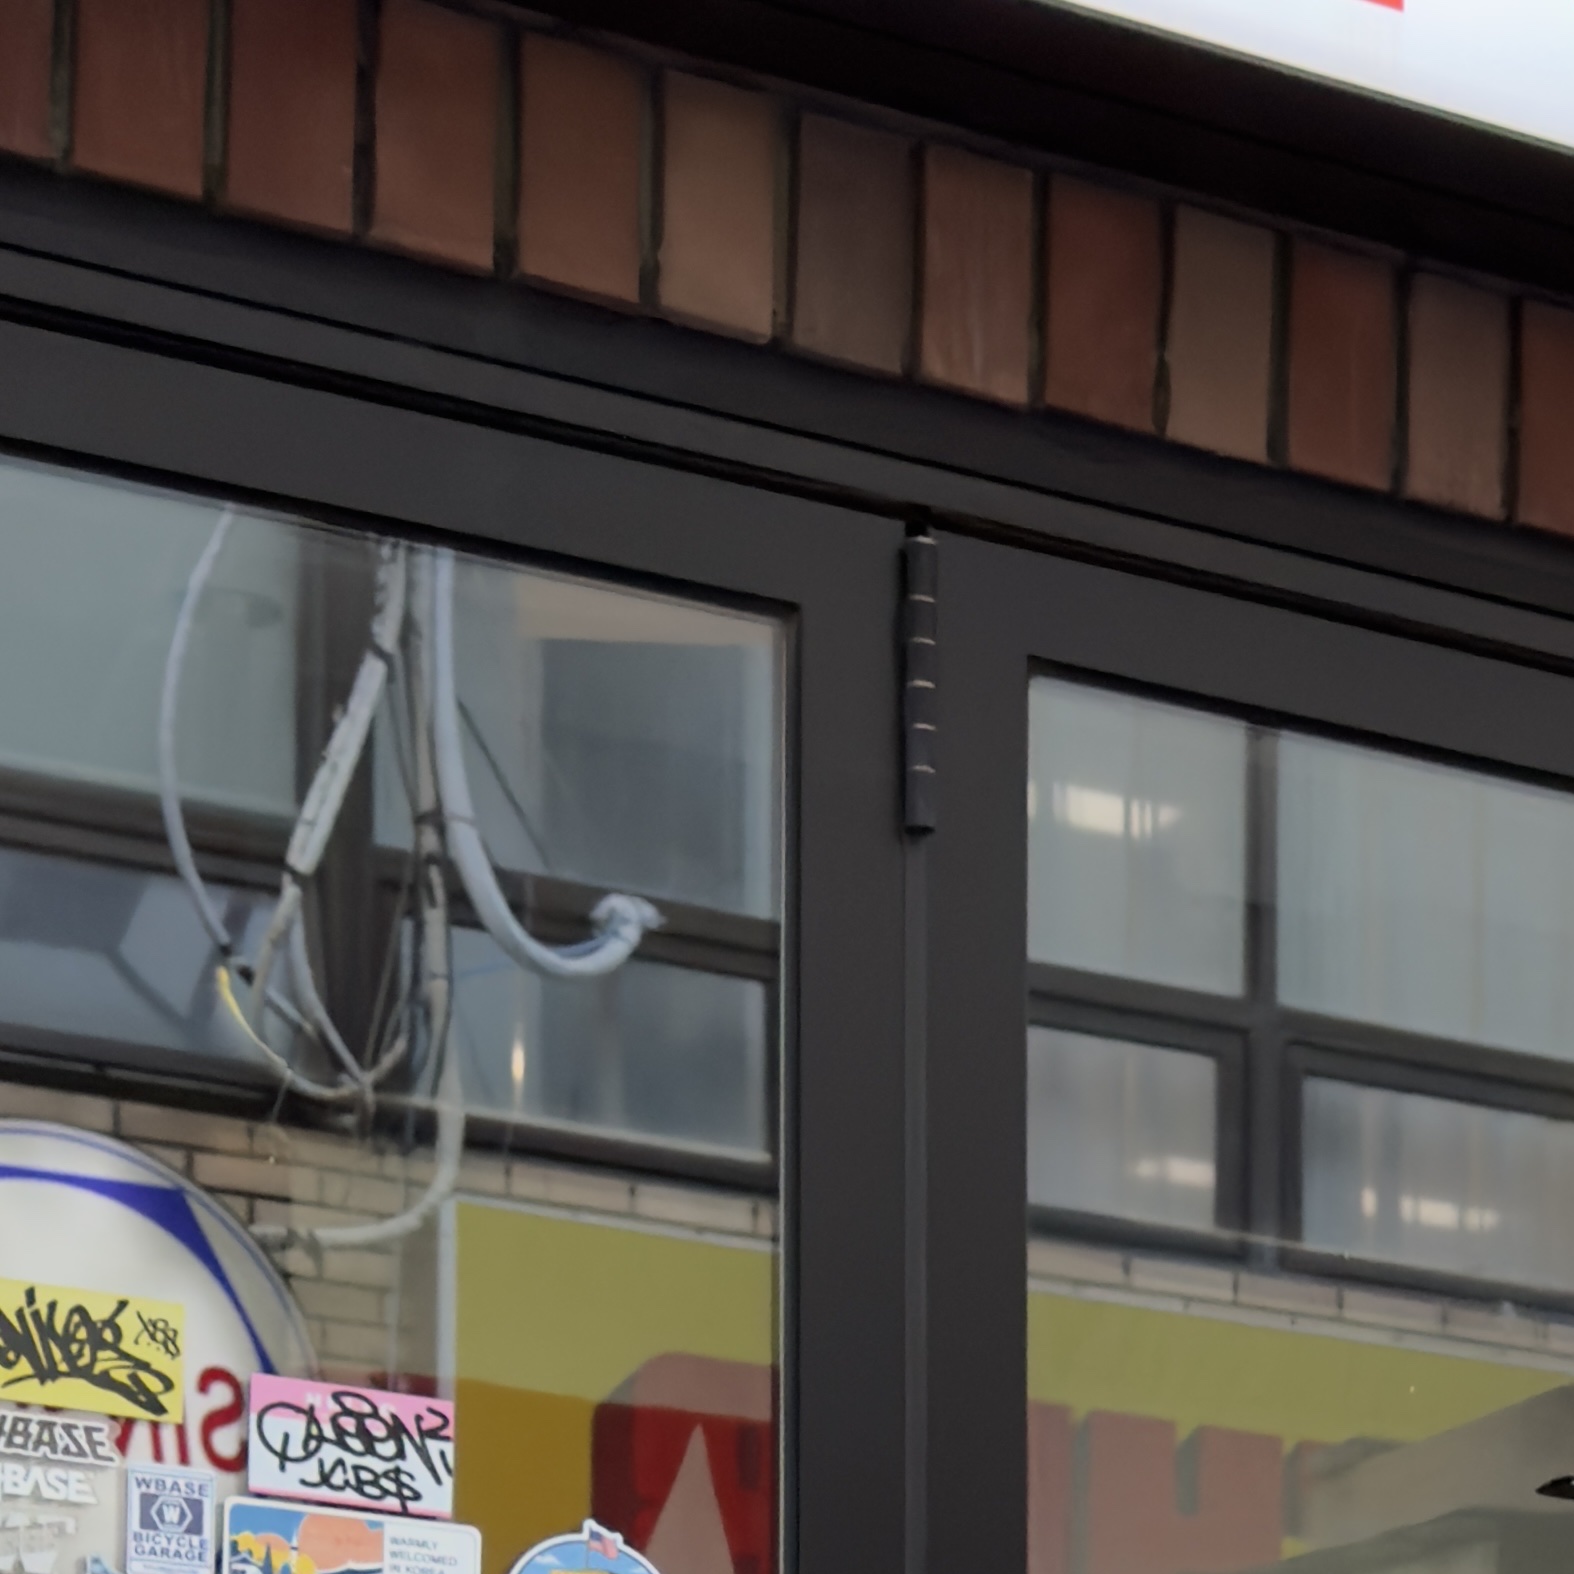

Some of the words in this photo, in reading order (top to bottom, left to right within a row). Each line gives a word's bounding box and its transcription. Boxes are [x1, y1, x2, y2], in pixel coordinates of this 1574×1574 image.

[135, 1476, 209, 1499] WBASE
[132, 1532, 208, 1552] BICYCLE
[134, 1545, 207, 1564] GARAGE
[389, 1550, 458, 1567] WELCOMED
